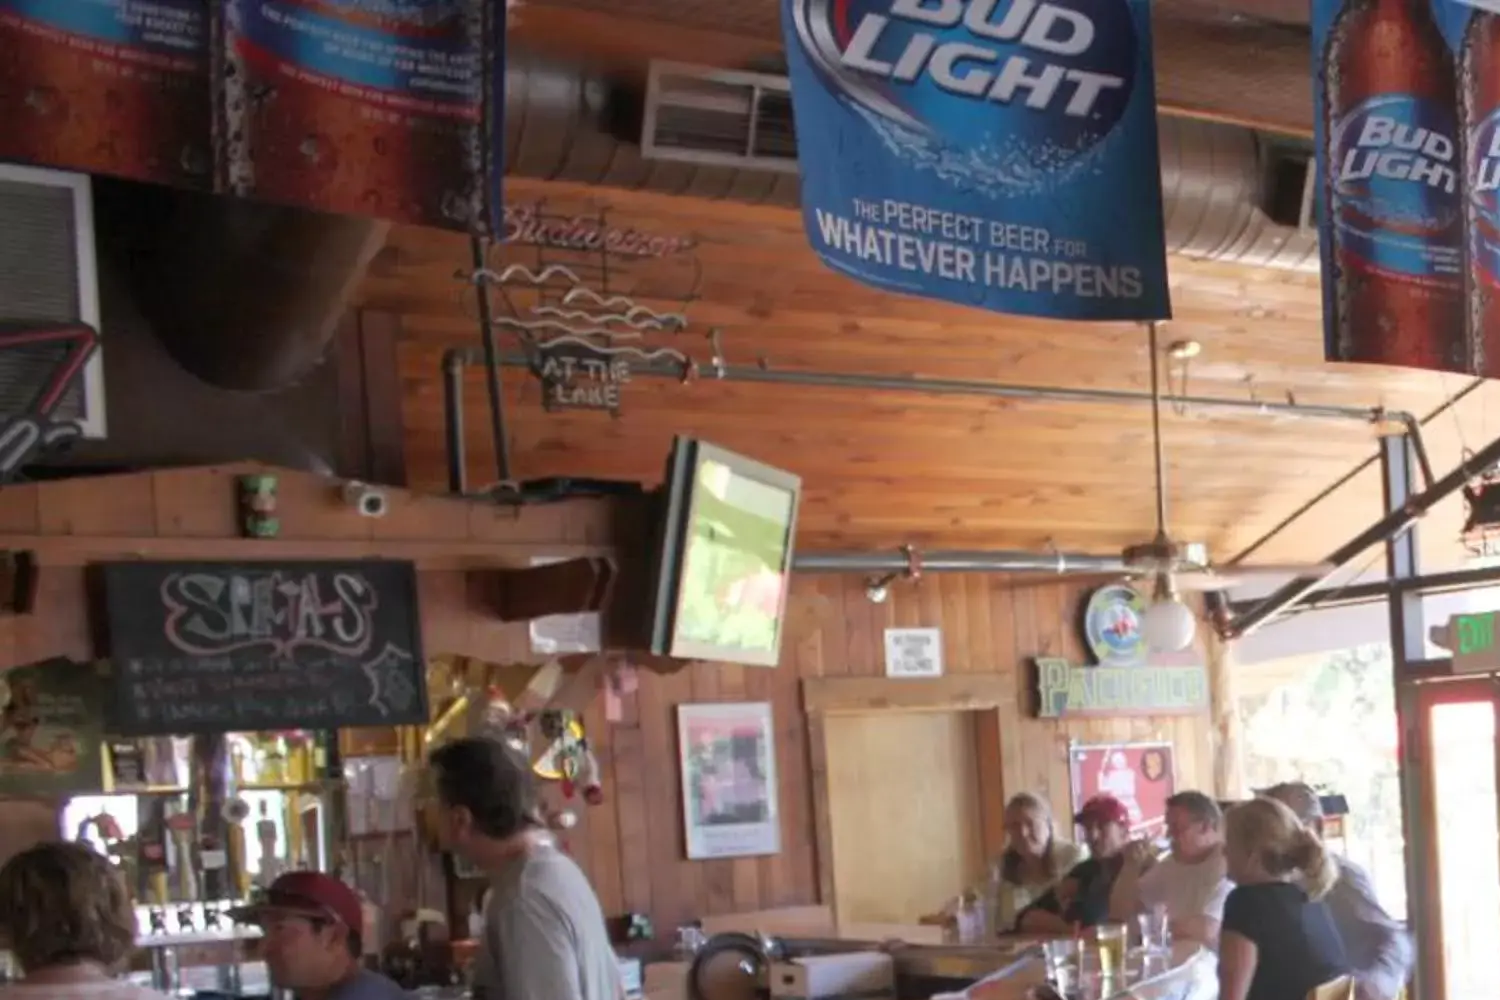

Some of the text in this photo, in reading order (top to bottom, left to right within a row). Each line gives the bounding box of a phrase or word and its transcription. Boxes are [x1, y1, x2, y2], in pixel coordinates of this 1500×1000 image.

[840, 13, 1124, 117] LIGHT
[1358, 116, 1452, 161] BUD
[1340, 148, 1456, 193] LIGHT
[852, 198, 1087, 257] THE PERFECT BEER FOR
[815, 208, 976, 283] WHATEVER
[984, 254, 1144, 299] HAPPENS
[543, 357, 577, 381] AT
[556, 383, 620, 407] LAKE
